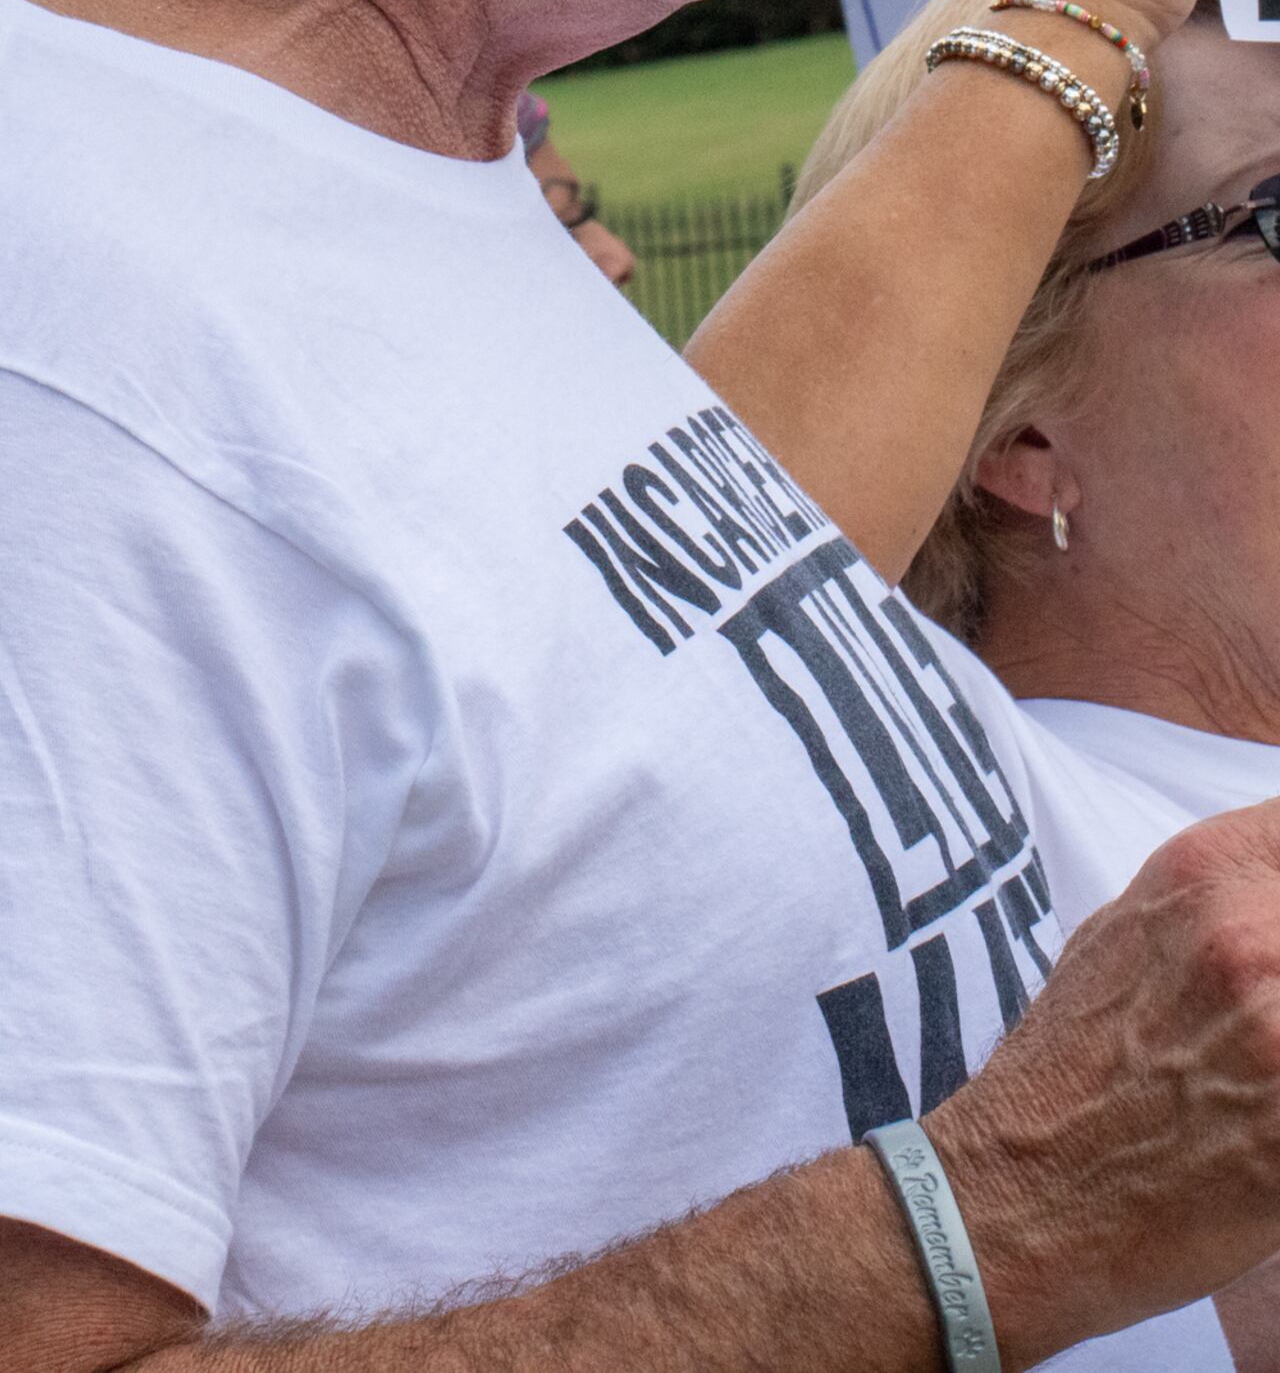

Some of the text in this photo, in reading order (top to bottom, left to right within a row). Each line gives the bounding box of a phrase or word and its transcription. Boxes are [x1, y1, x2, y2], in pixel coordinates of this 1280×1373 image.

[562, 406, 830, 658] INCARCER
[756, 558, 1014, 904] LIVE
[902, 1172, 974, 1321] Remember
